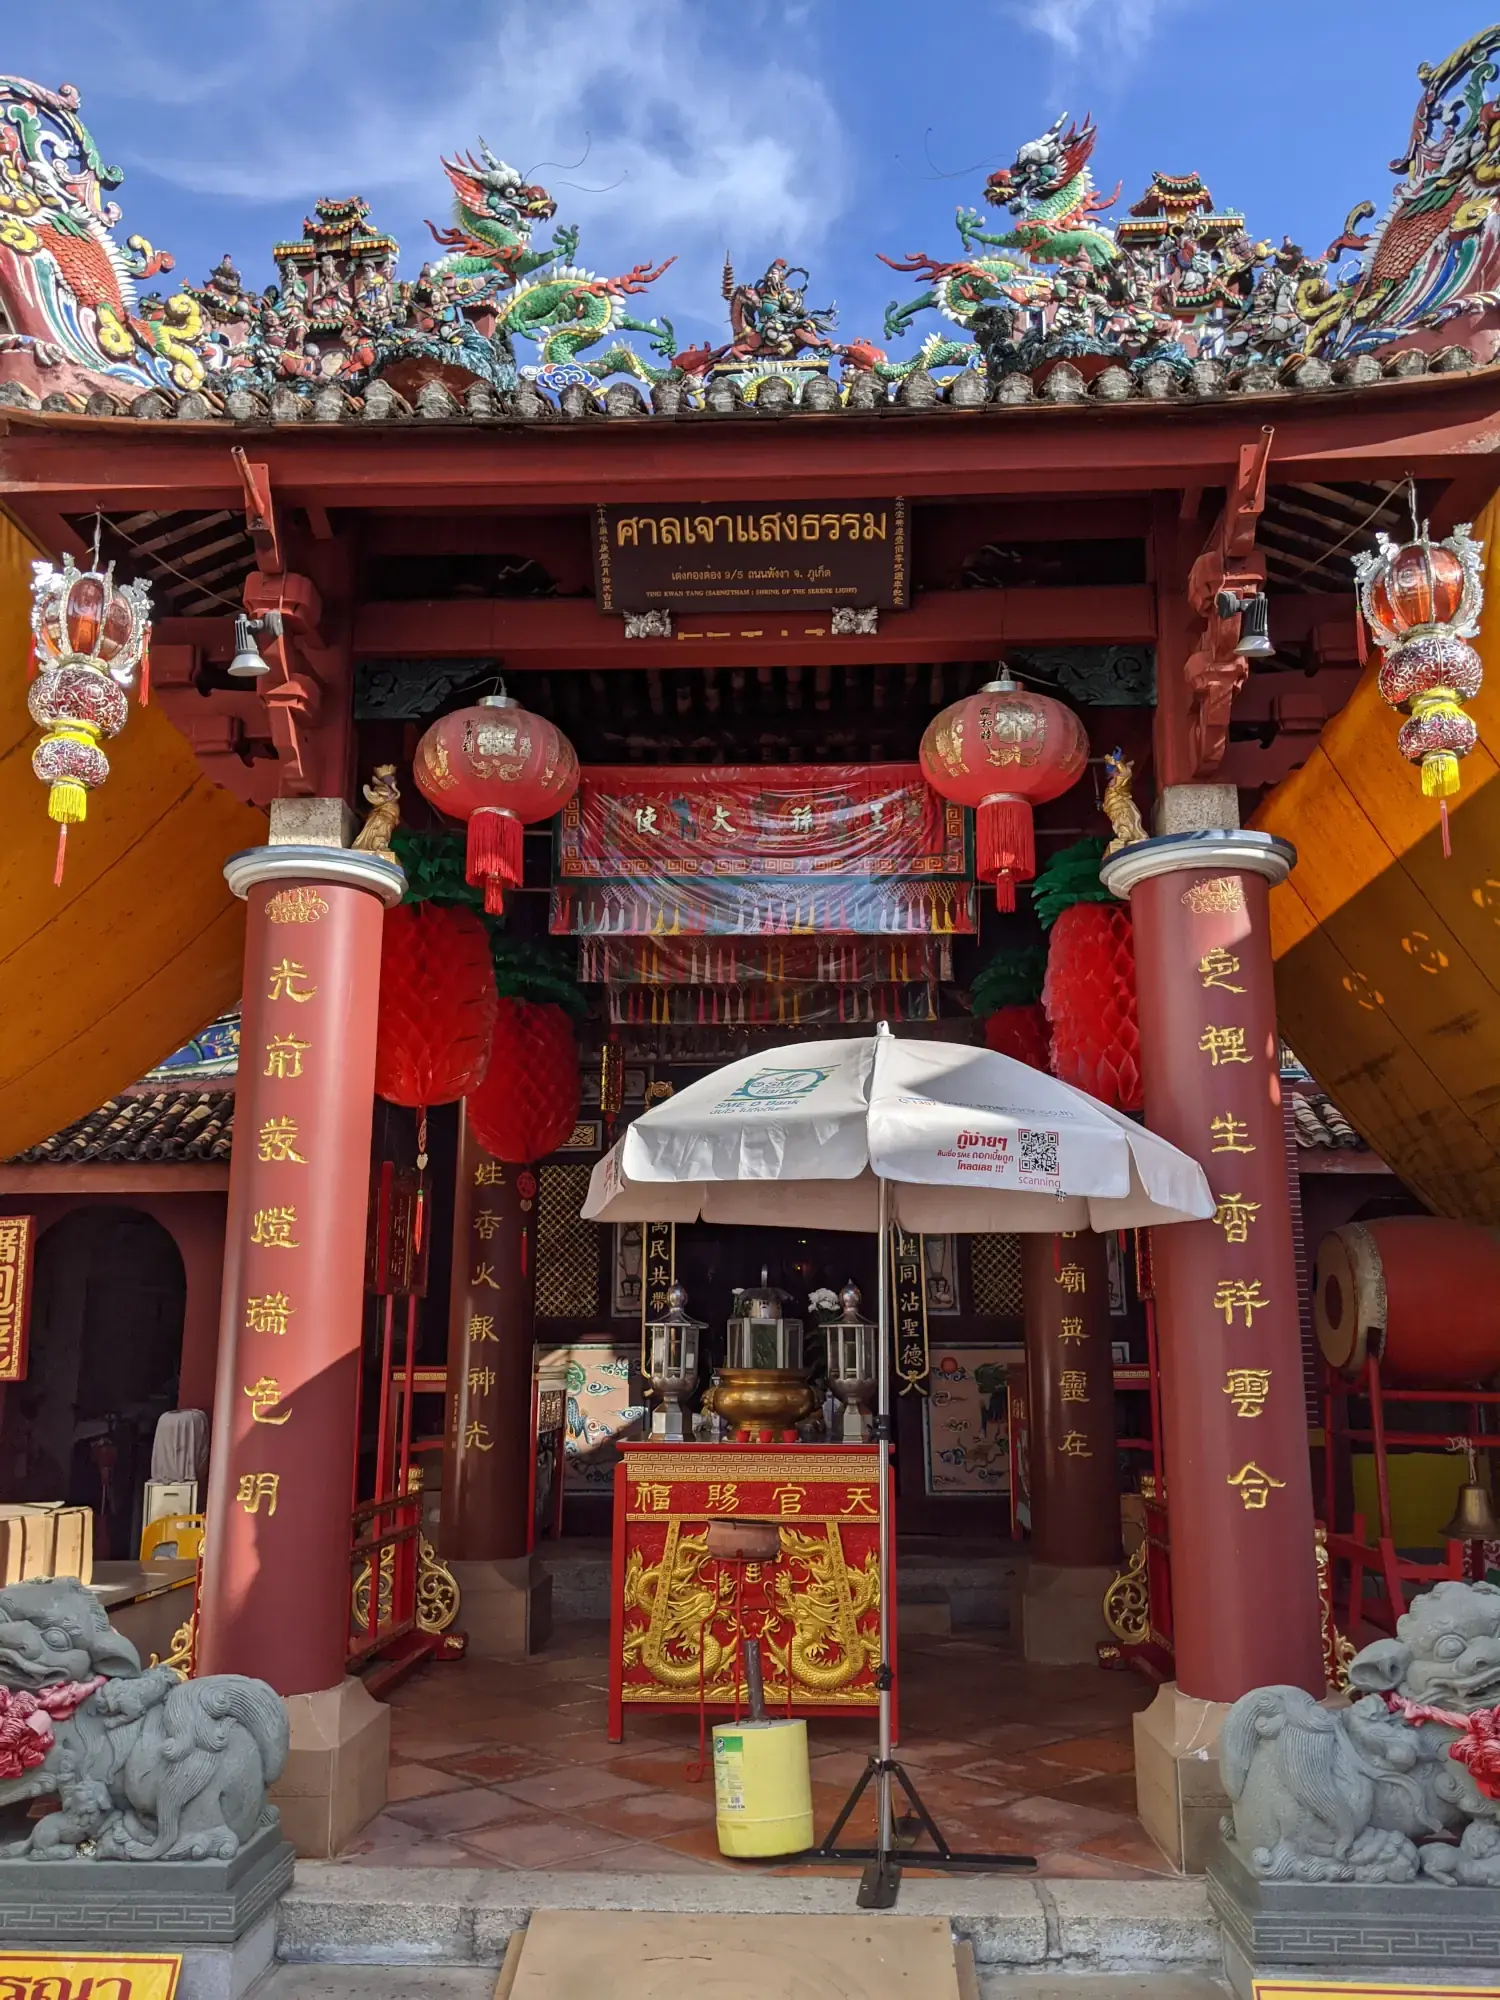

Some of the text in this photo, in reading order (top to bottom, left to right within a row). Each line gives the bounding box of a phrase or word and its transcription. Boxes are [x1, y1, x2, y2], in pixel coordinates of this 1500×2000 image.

[725, 568, 744, 580] 9/5
[764, 1080, 802, 1088] SME
[714, 1101, 745, 1109] SME
[957, 1130, 1008, 1152] กู้ง่ายๆ
[1018, 1175, 1061, 1190] scanning
